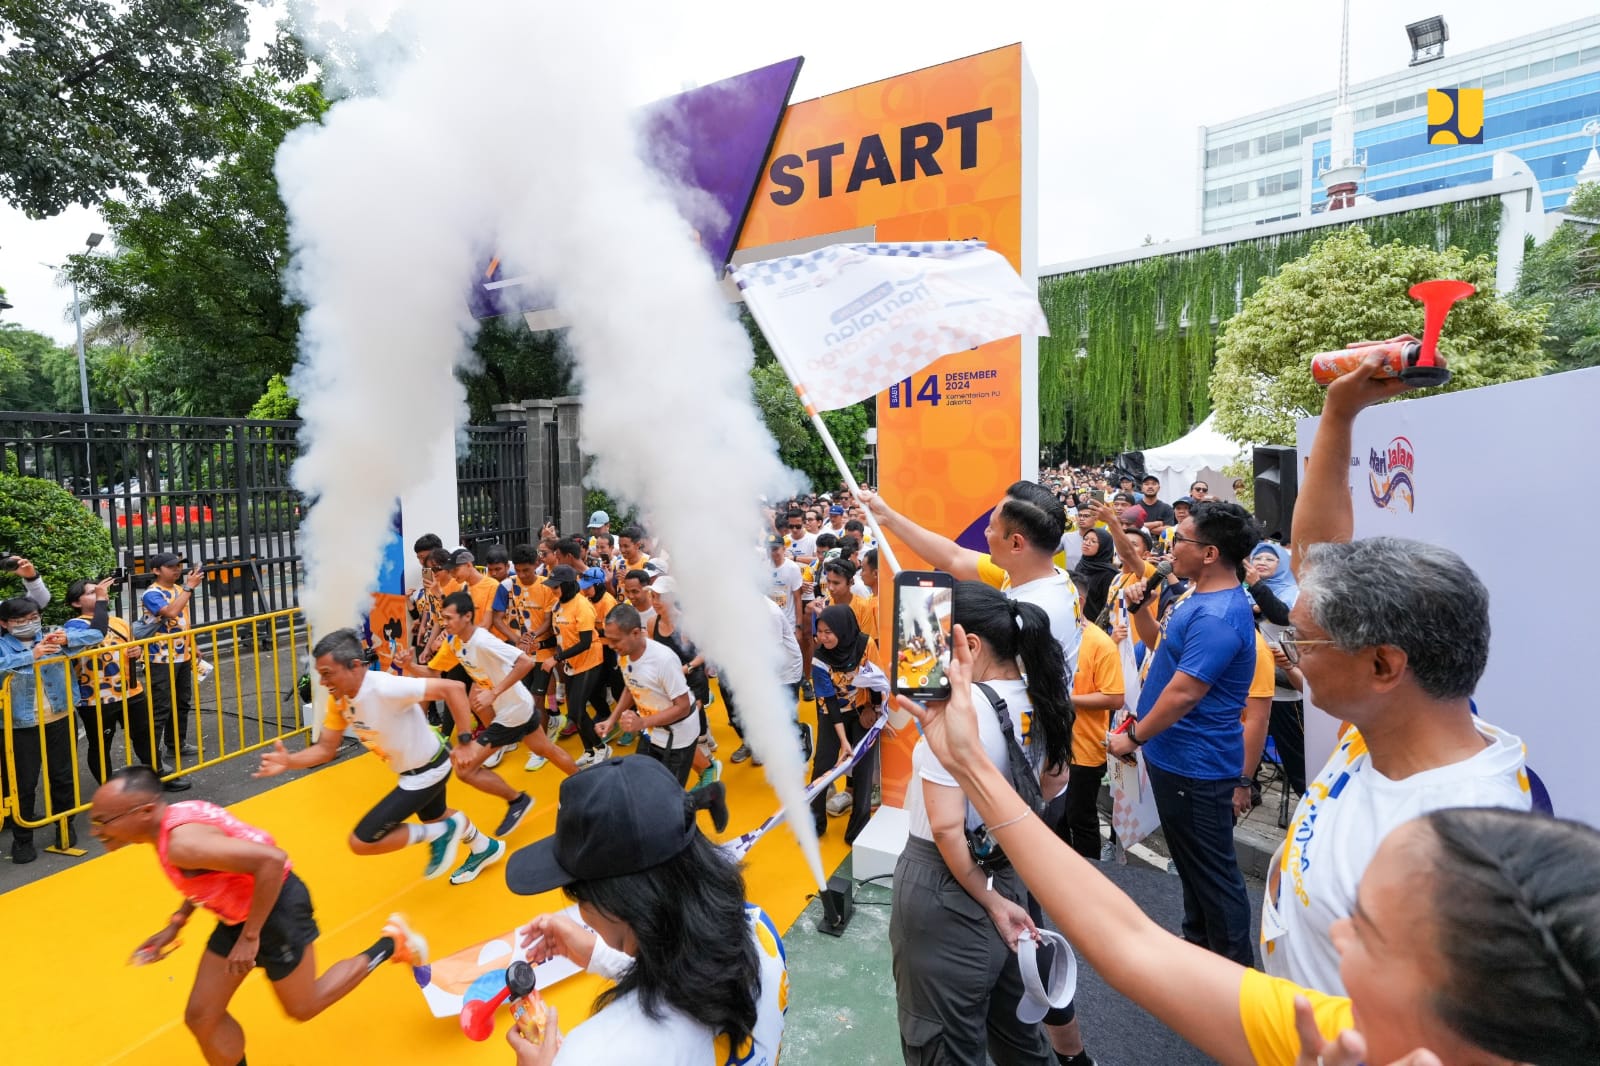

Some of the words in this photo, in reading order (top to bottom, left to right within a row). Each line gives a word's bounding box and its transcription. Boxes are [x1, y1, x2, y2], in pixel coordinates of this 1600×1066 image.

[769, 107, 993, 206] START
[945, 370, 997, 382] DESEMBER
[945, 381, 970, 391] 2024
[900, 374, 942, 408] 14
[946, 391, 990, 400] Kementerian
[1369, 447, 1387, 474] Hari
[1387, 442, 1414, 473] Jalan
